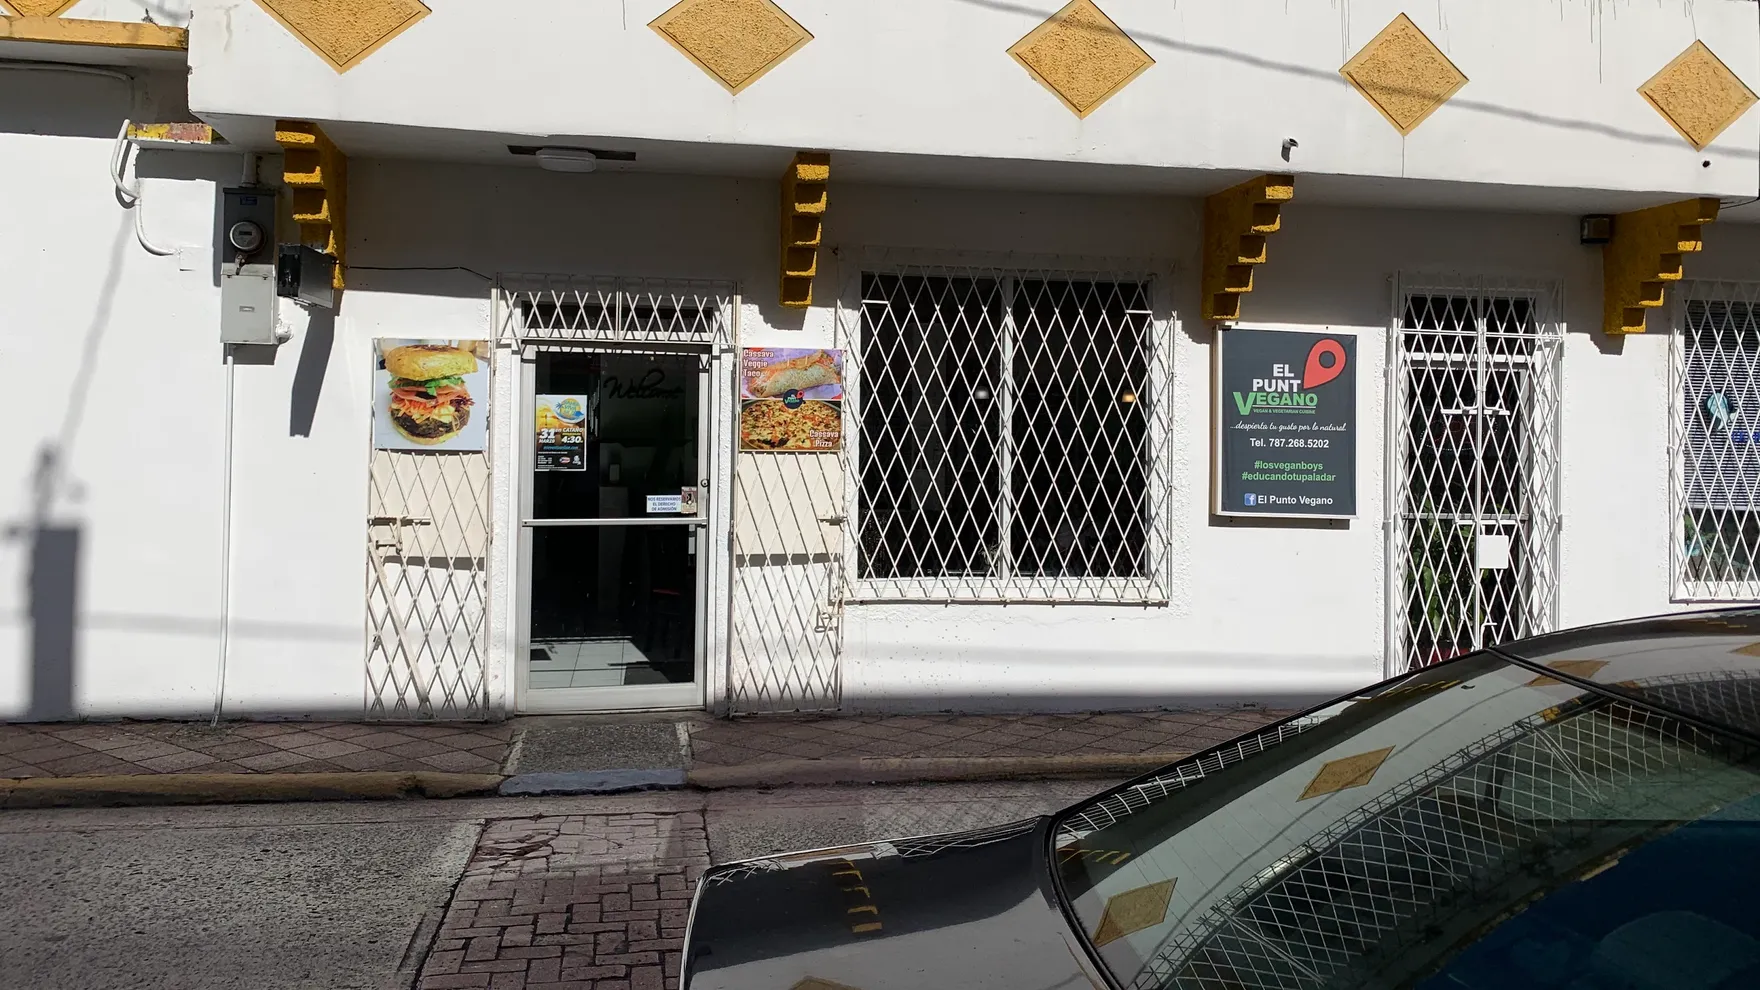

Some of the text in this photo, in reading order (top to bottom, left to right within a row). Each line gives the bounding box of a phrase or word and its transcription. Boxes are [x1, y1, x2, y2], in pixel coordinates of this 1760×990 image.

[743, 350, 774, 358] Cassava
[743, 360, 768, 368] Veggie
[1272, 363, 1295, 377] EL
[1232, 391, 1319, 416] VEGANO
[1269, 422, 1277, 430] tu
[1278, 422, 1298, 432] gusto
[1298, 424, 1311, 433] por
[1312, 422, 1319, 431] lo
[539, 428, 556, 439] 31
[809, 429, 839, 438] Cassava
[561, 436, 582, 444] 4:30
[1249, 438, 1330, 448] Tel. 787.268.5202
[1254, 460, 1324, 471] #losveganboys
[1241, 472, 1336, 483] #educandotupaladar
[1258, 495, 1267, 504] El
[1269, 495, 1297, 505] Punto
[1299, 496, 1333, 507] Vegano
